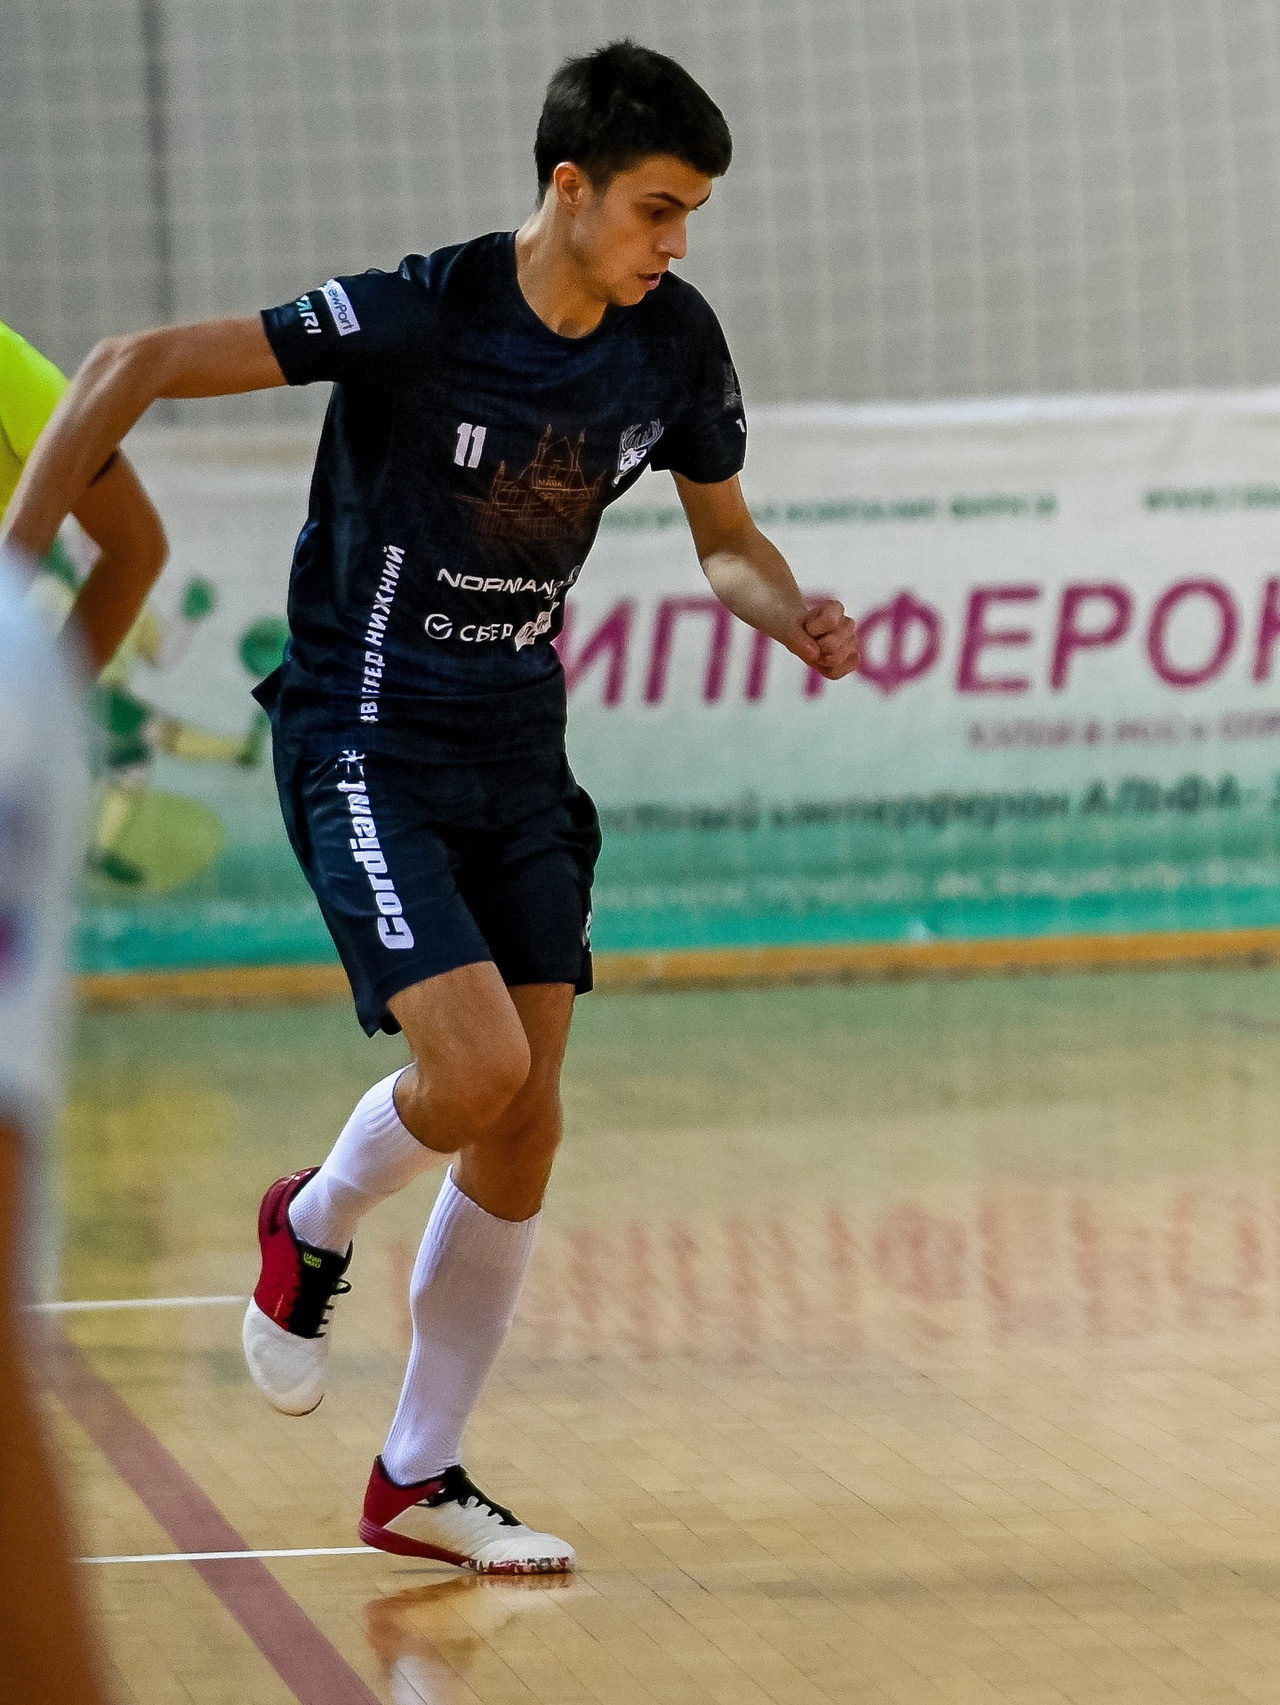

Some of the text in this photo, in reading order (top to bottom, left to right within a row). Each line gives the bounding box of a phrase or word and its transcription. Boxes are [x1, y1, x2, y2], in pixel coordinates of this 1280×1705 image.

[453, 422, 487, 469] 11
[364, 544, 406, 647] НИЖНИЙ
[460, 623, 514, 643] СБЕР
[337, 778, 415, 949] Cordiant
